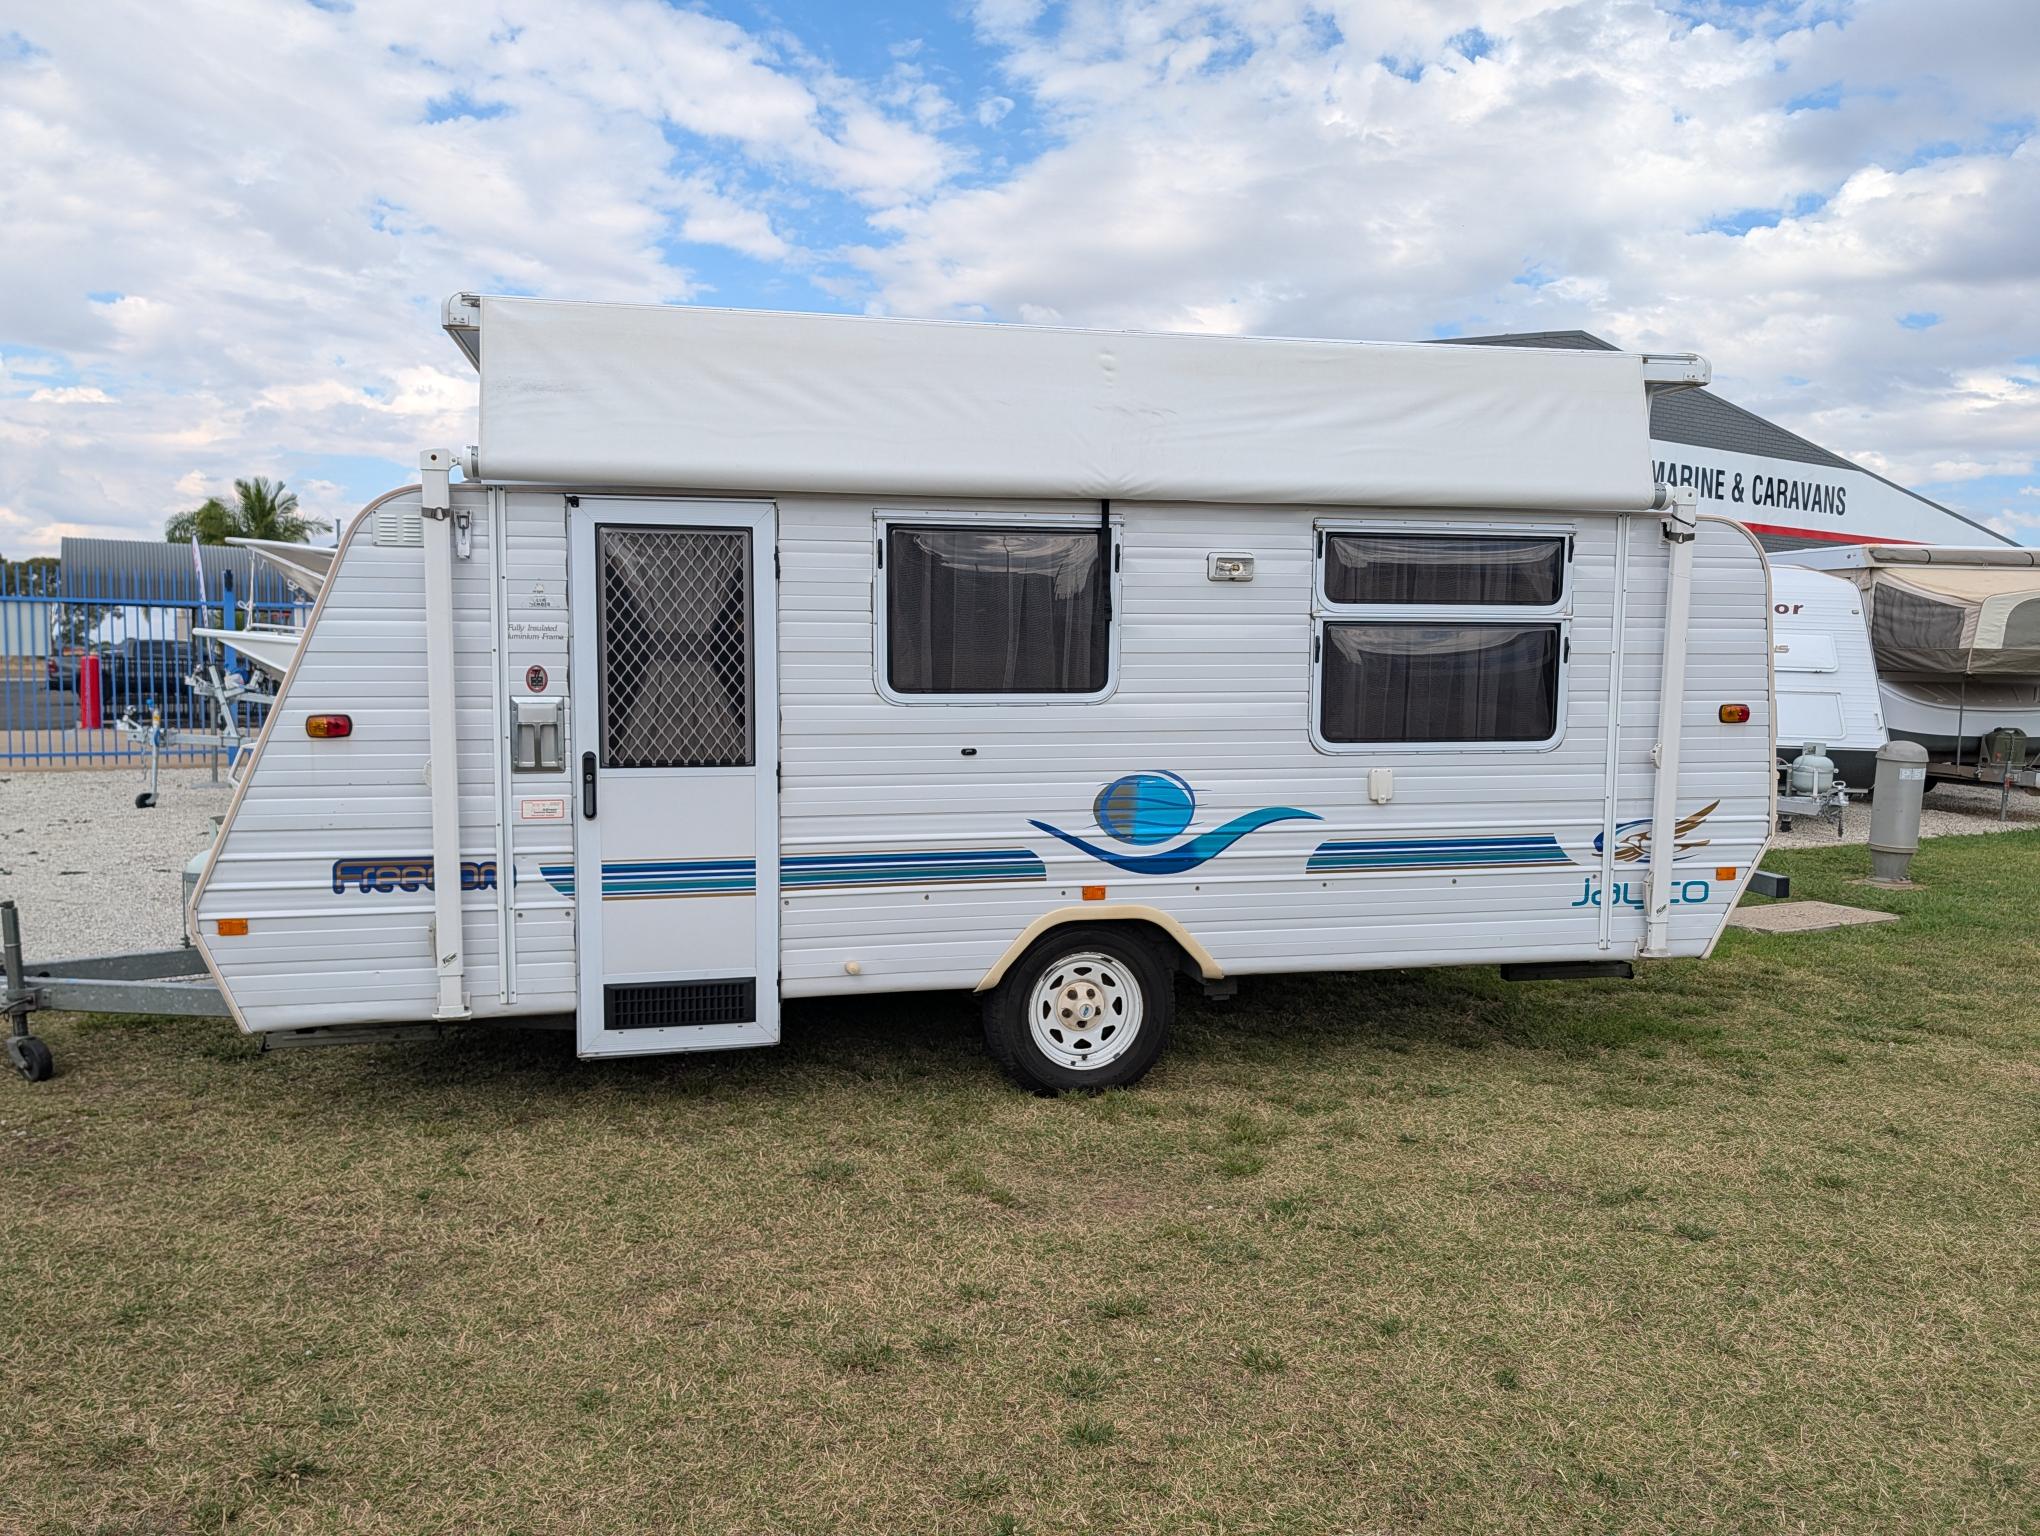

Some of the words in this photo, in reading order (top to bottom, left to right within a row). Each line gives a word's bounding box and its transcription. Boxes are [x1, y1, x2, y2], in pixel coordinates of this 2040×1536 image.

[1731, 472, 1745, 503] &
[1752, 474, 1847, 516] CARAVANS
[508, 624, 525, 632] Fully
[528, 624, 558, 632] Insulated
[333, 856, 517, 894] Freeom
